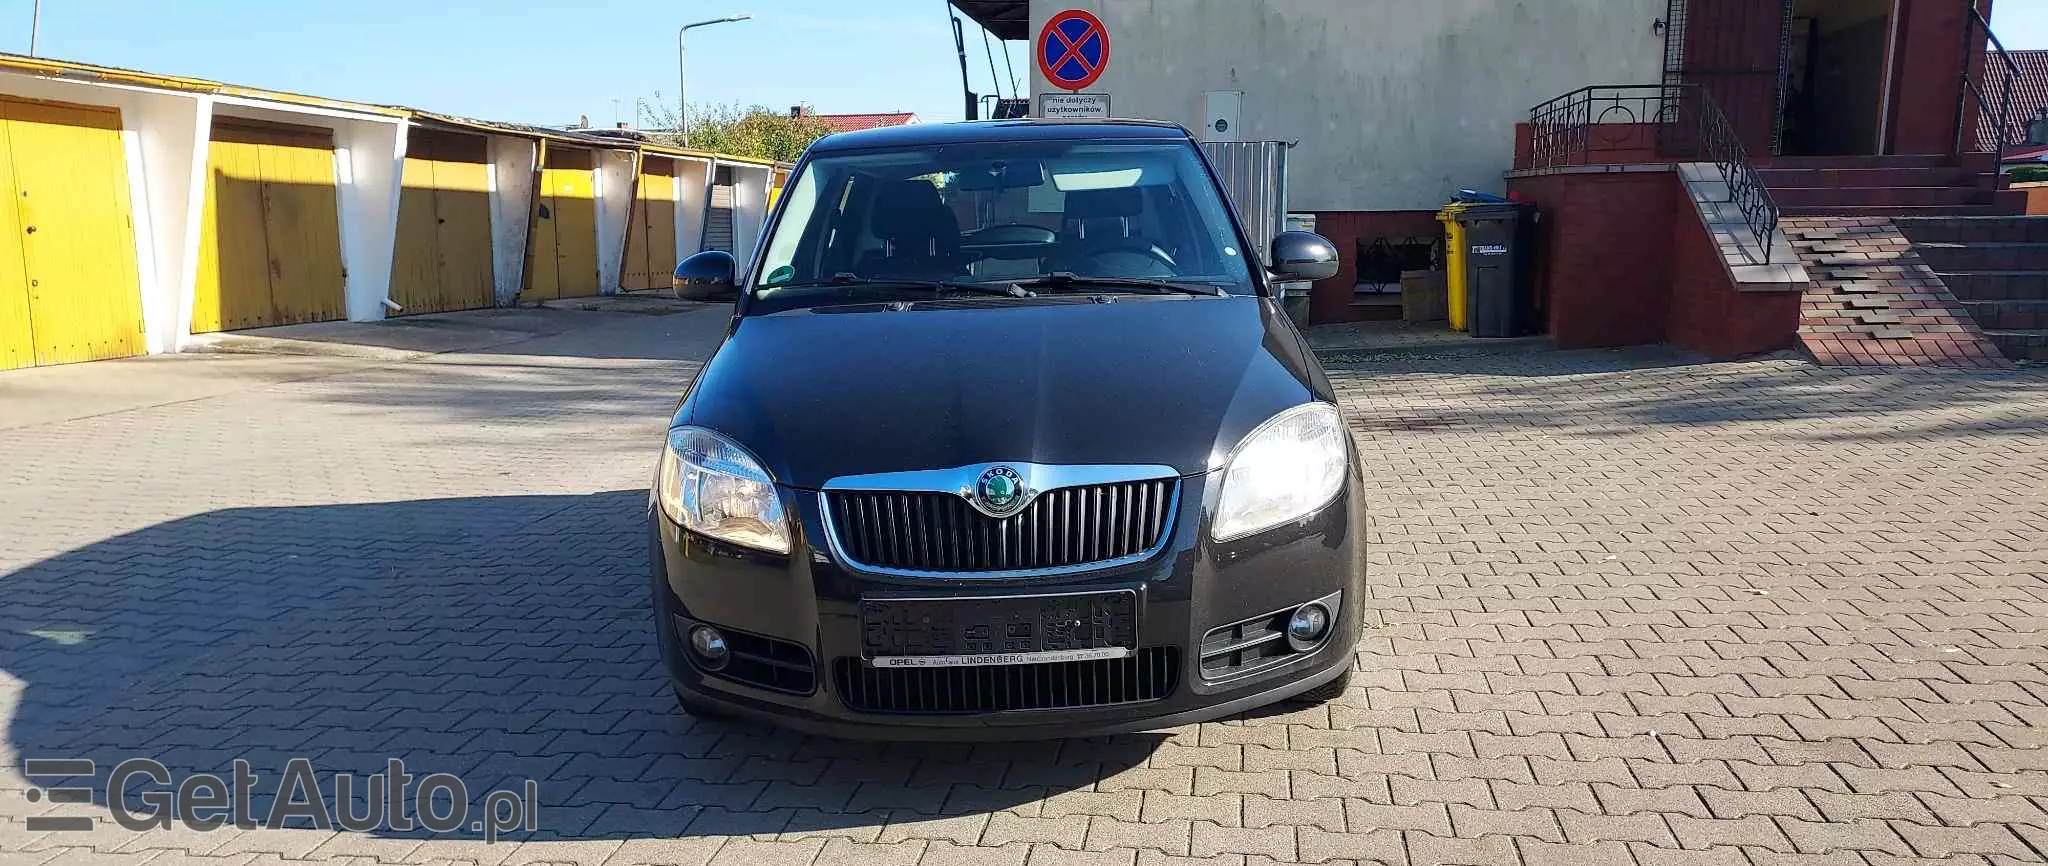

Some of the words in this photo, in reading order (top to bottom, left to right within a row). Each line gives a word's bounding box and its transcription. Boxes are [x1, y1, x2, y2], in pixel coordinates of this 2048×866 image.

[1052, 96, 1064, 104] nie
[1066, 96, 1096, 105] dotyczy
[889, 658, 917, 666] OPEL
[961, 655, 1024, 665] LINDENBERG
